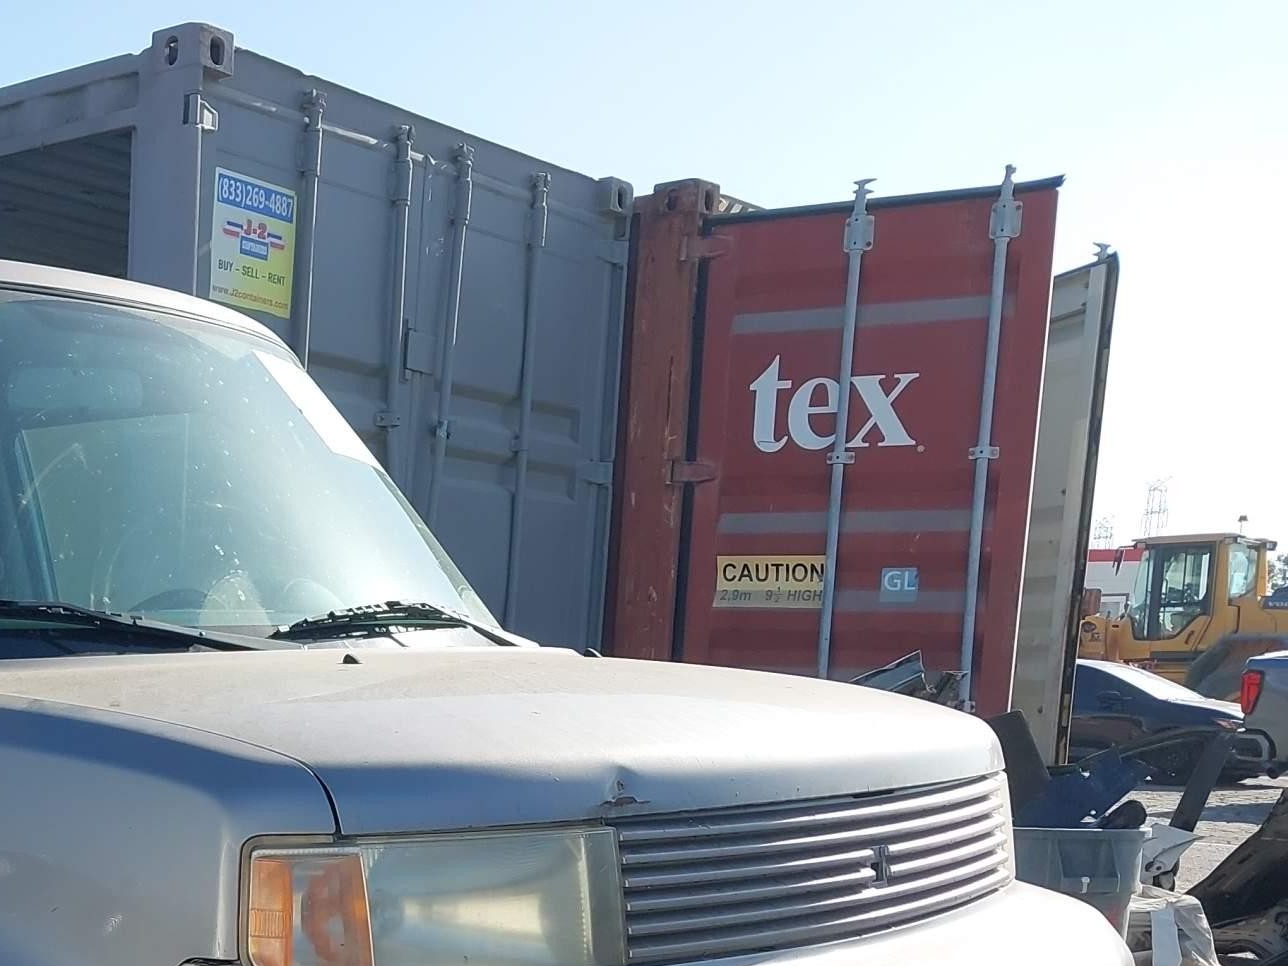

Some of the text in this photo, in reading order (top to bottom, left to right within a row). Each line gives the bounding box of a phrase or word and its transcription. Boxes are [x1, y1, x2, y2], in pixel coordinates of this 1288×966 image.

[218, 177, 293, 218] (833)269-4887
[244, 219, 267, 240] J-2
[218, 259, 234, 273] BUY
[241, 265, 259, 280] SELL
[268, 272, 285, 287] RENT
[749, 355, 919, 453] tex
[722, 563, 825, 582] CAUTION
[884, 571, 916, 591] GL
[787, 590, 823, 602] HIGH
